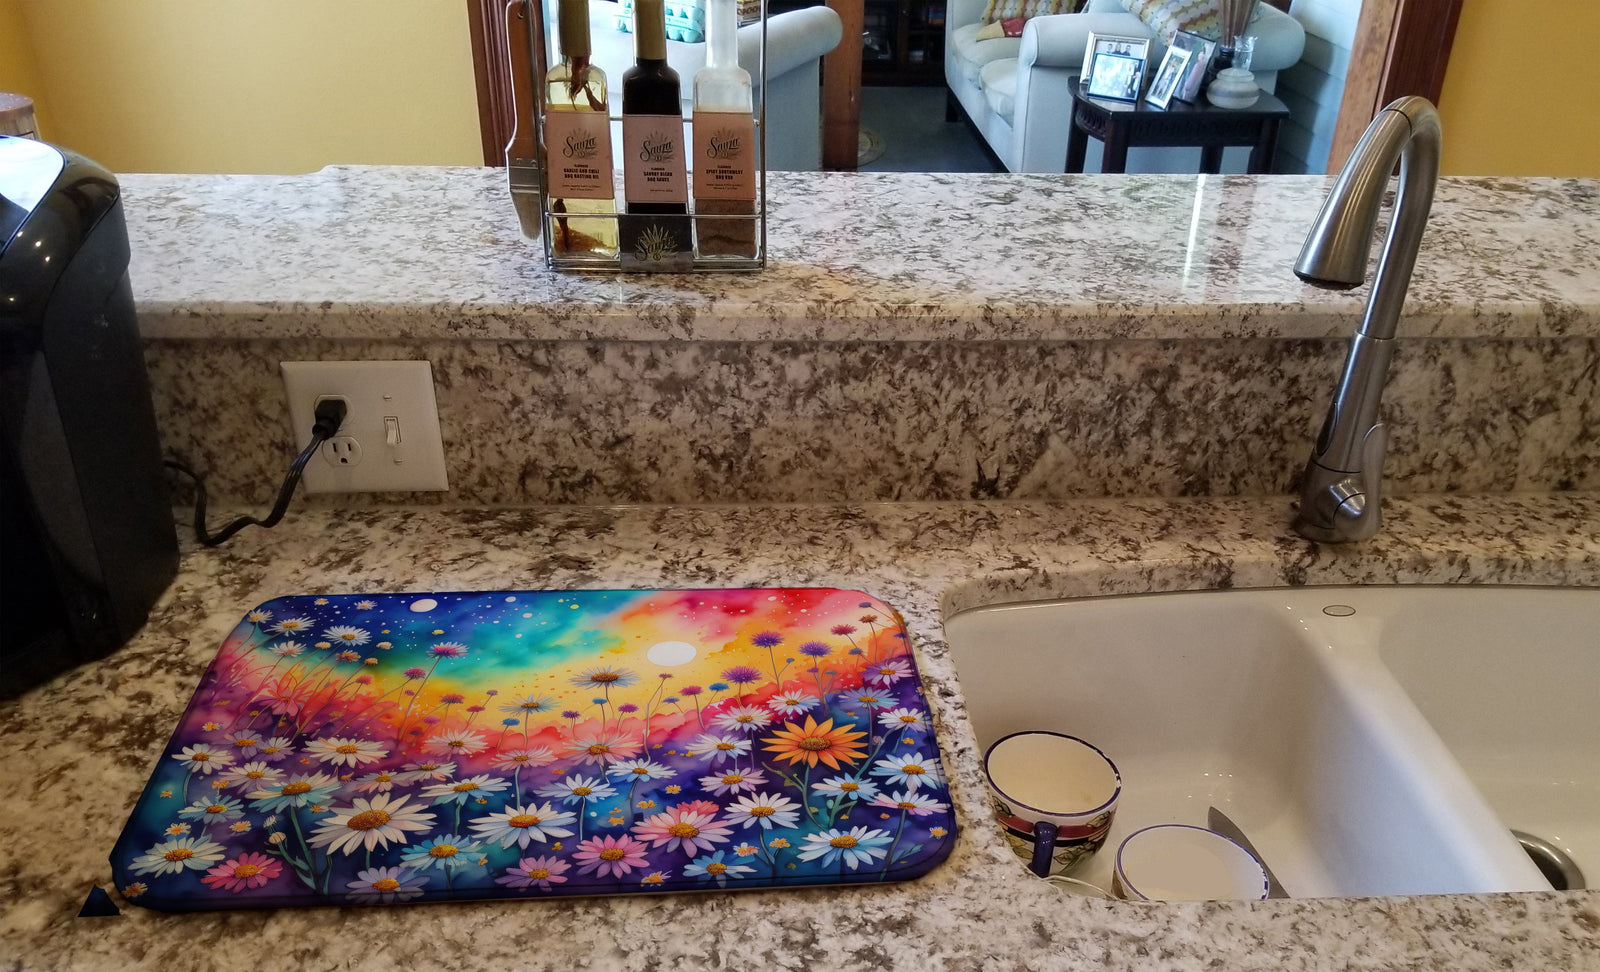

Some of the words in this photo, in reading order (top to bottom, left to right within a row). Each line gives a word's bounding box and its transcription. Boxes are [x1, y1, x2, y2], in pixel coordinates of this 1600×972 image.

[563, 136, 598, 158] Sauza
[640, 141, 673, 161] Sauza
[707, 137, 740, 158] Sauza
